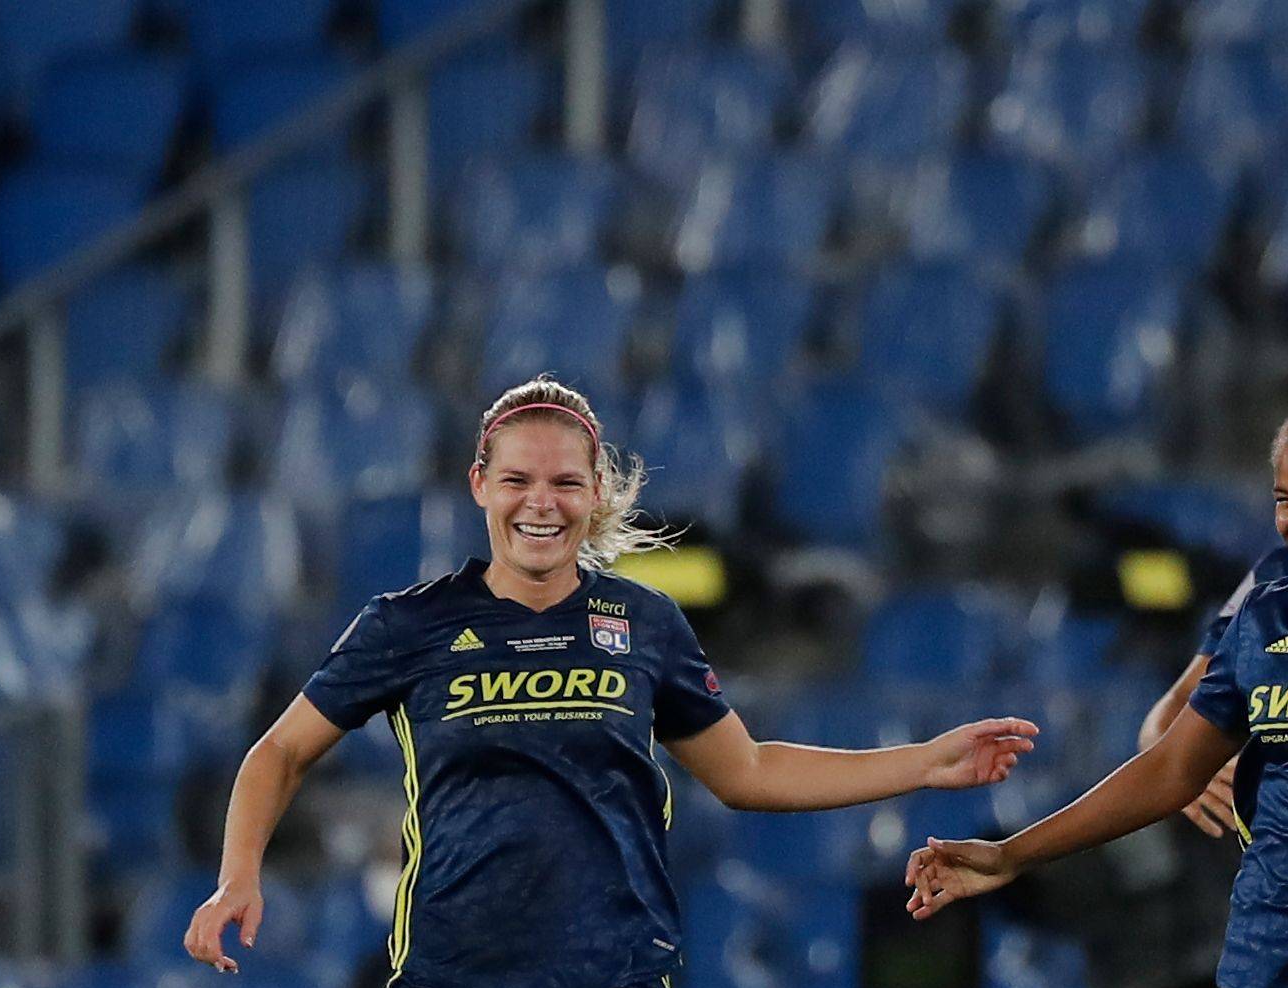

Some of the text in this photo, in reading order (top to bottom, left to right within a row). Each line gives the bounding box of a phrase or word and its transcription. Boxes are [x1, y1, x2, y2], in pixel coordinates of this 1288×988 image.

[587, 597, 626, 616] Merci
[445, 668, 627, 710] SWORD
[473, 711, 603, 726] UPGRADE YOUR BUSINESS
